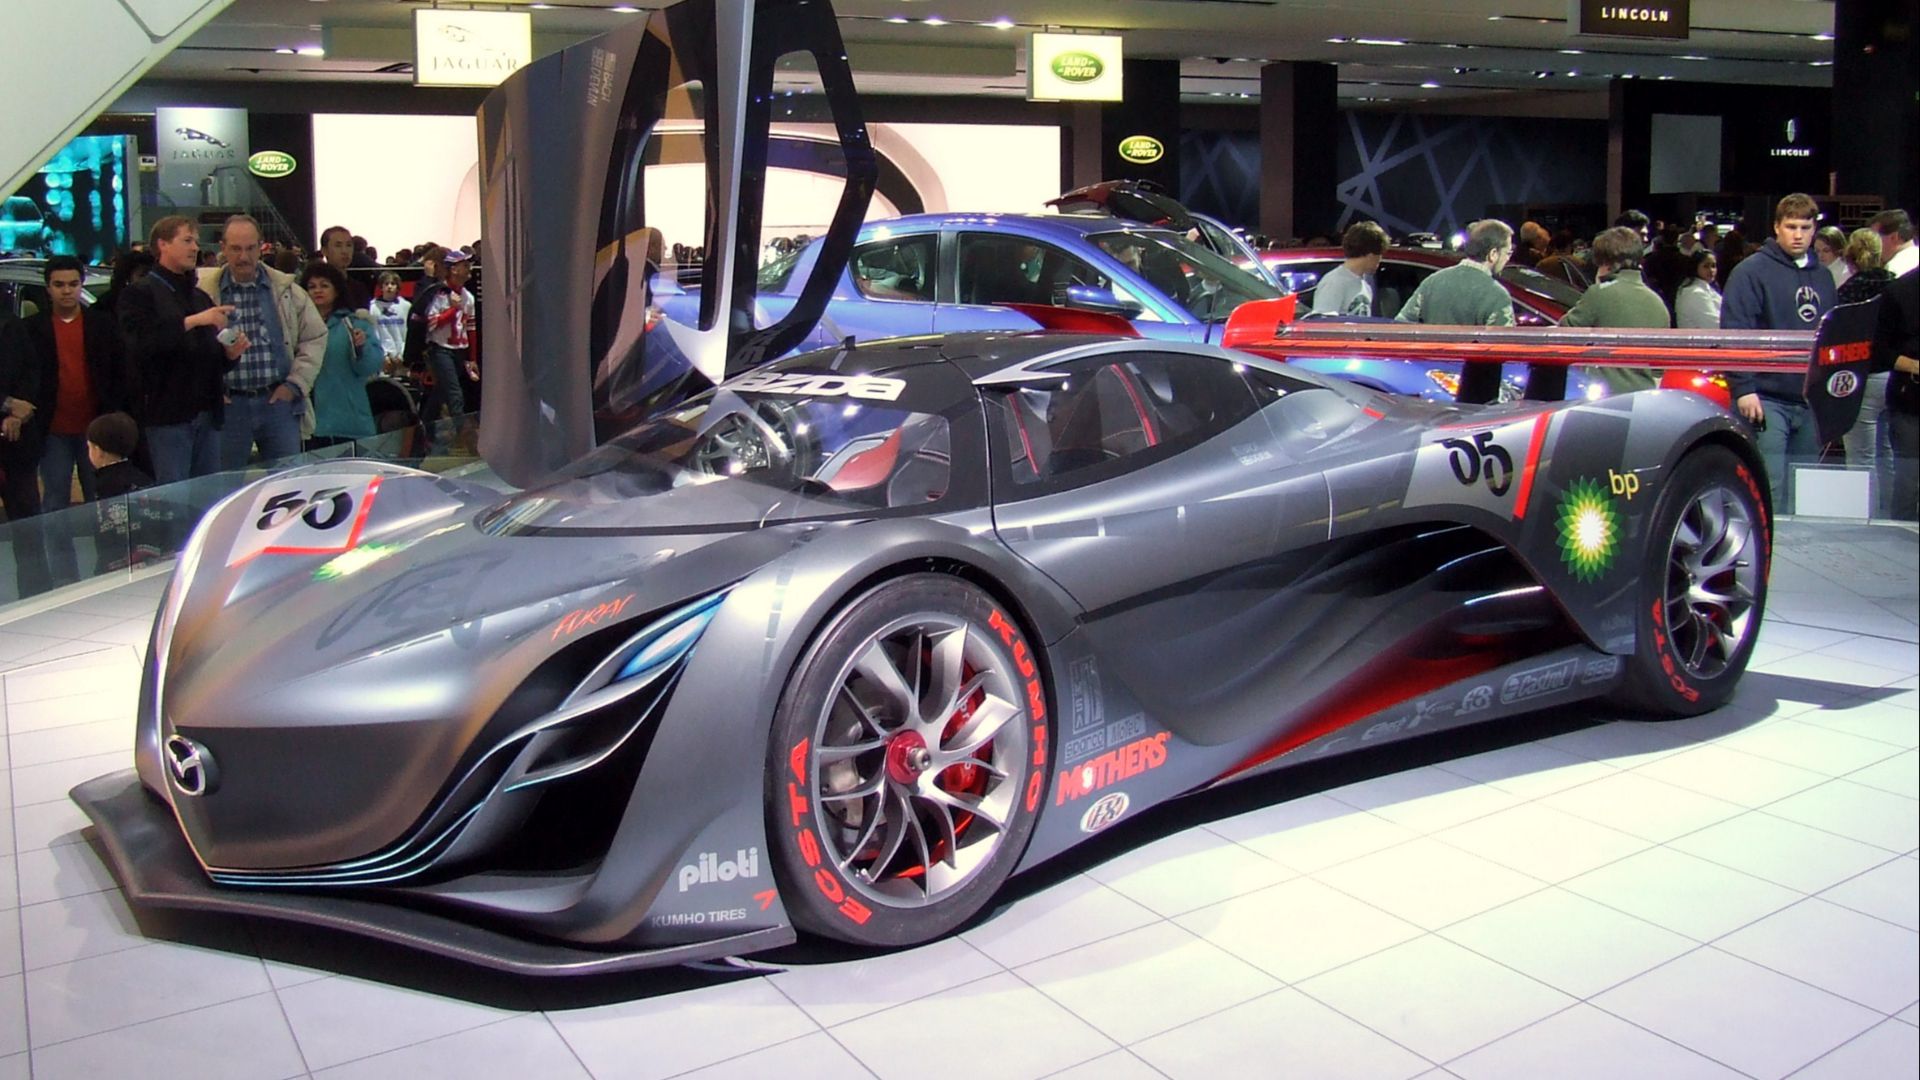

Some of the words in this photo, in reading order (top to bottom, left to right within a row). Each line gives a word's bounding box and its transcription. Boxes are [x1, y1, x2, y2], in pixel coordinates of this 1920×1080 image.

[1601, 7, 1669, 22] LINCOLN
[433, 56, 518, 71] JAGUAR
[1061, 57, 1089, 67] LAND
[1063, 67, 1097, 77] ROVER
[1129, 141, 1151, 149] LAND
[1770, 148, 1810, 157] LINCOLN
[172, 149, 235, 160] JAGUAR
[1130, 149, 1158, 157] ROVER
[259, 163, 289, 171] ROVER
[1608, 468, 1640, 500] bp
[256, 486, 354, 530] 55
[988, 608, 1048, 813] KUMHO
[1056, 732, 1170, 806] MOTHERS
[788, 737, 873, 925] ECSTA
[678, 847, 759, 893] piloti
[651, 912, 705, 928] KUMHO
[708, 908, 748, 923] TIRES
